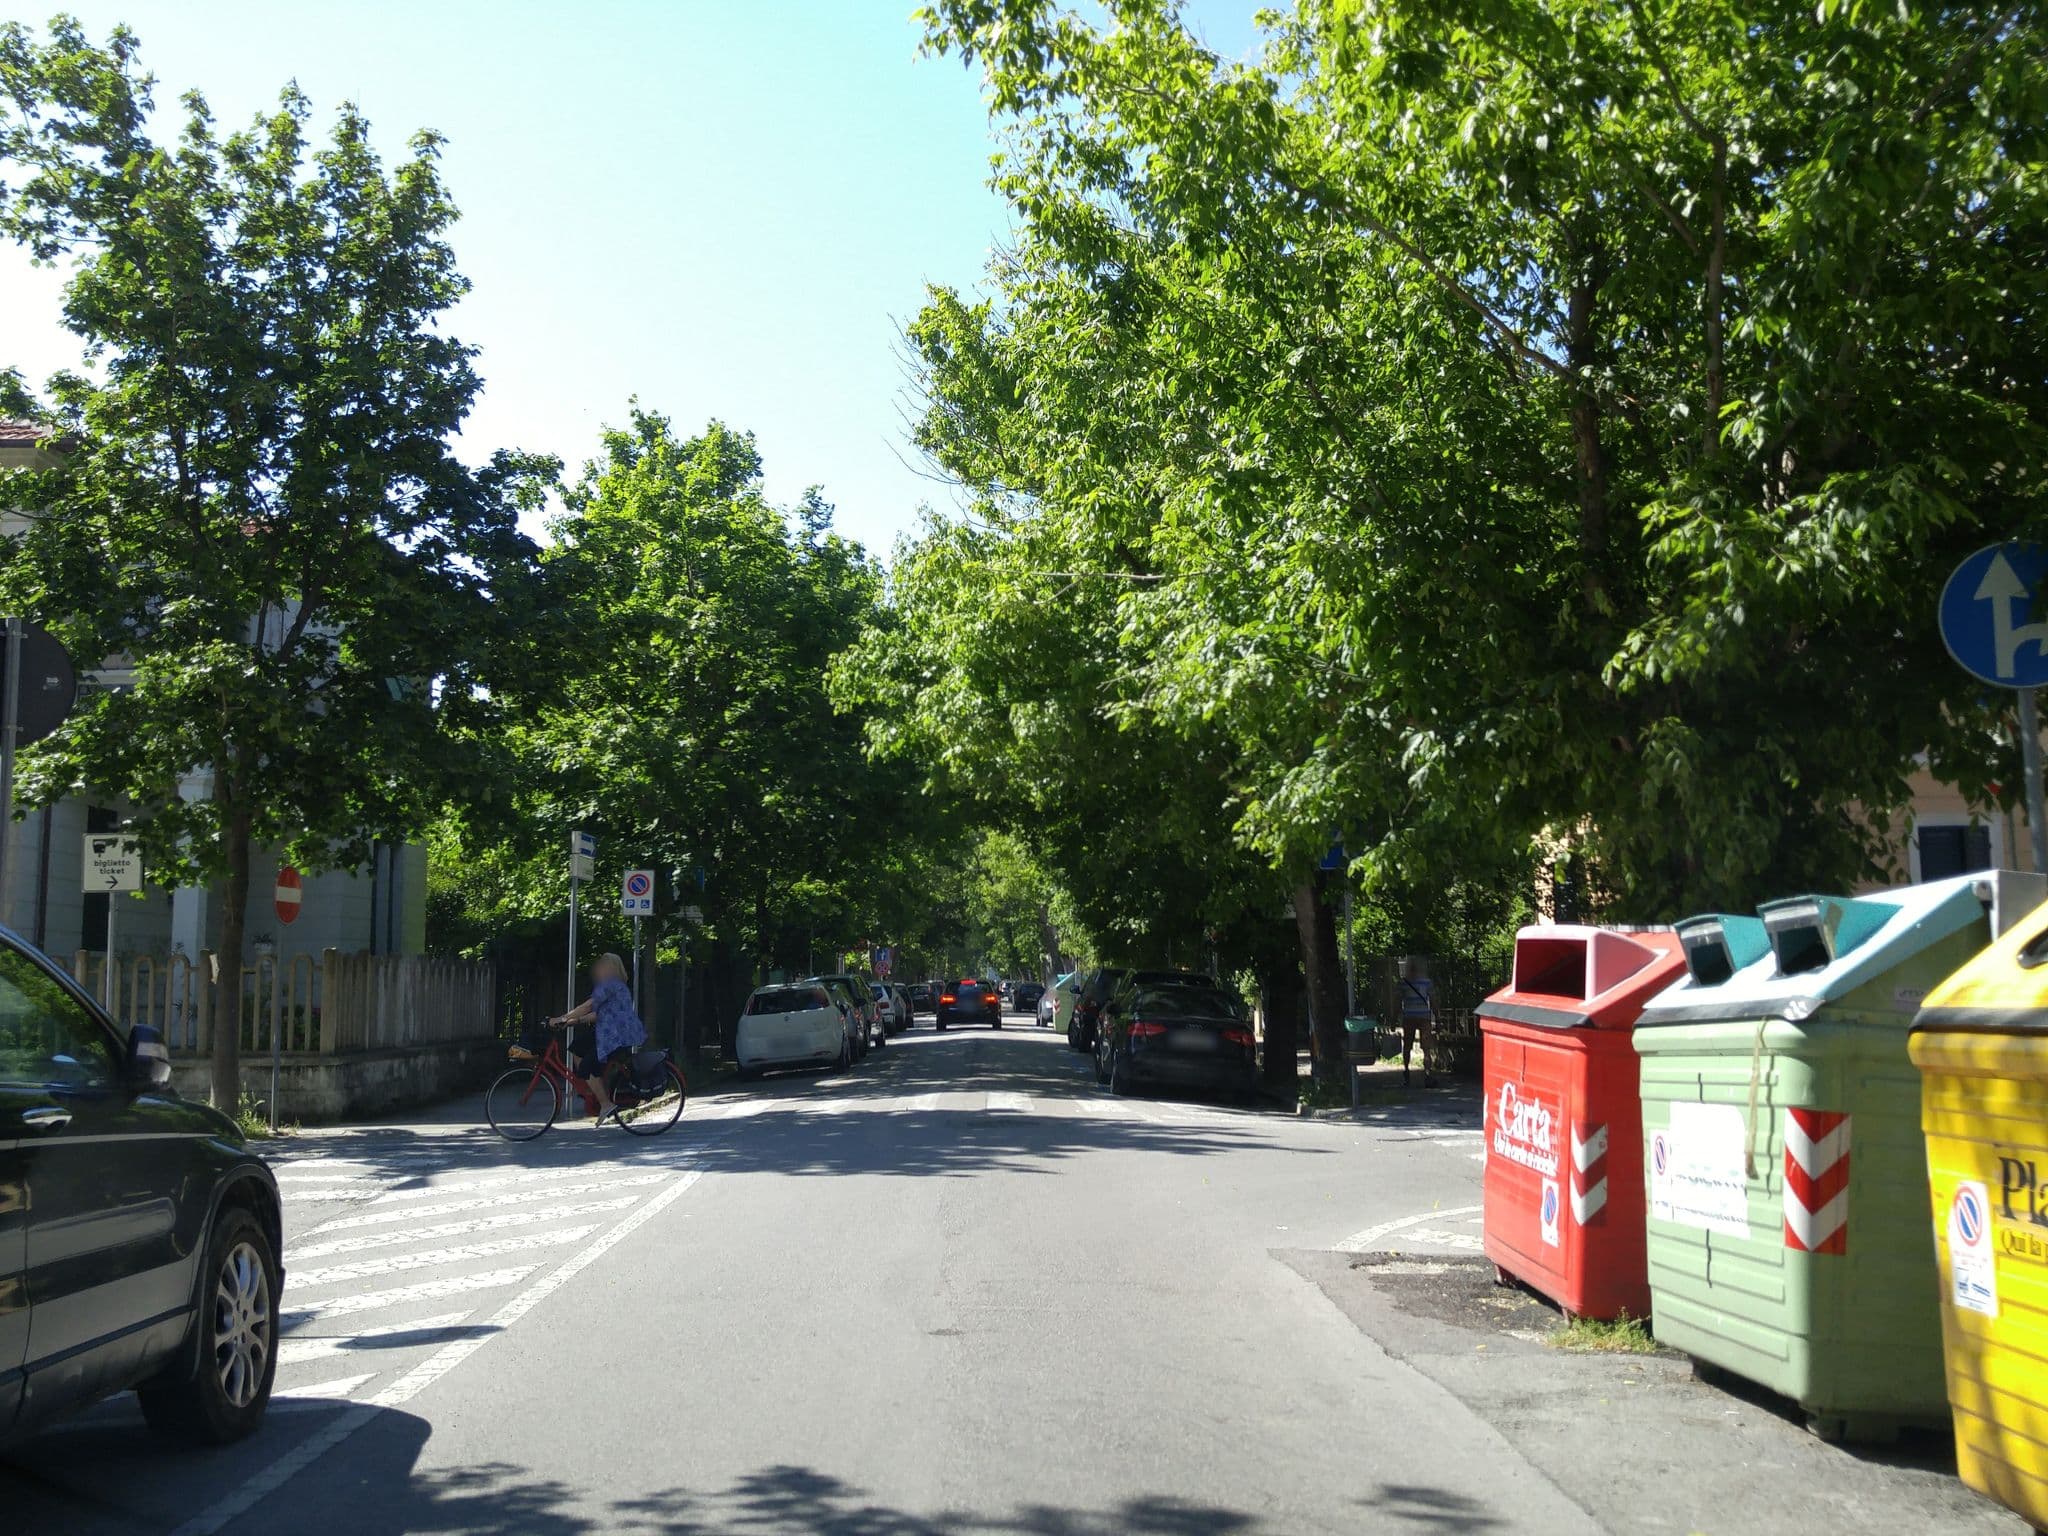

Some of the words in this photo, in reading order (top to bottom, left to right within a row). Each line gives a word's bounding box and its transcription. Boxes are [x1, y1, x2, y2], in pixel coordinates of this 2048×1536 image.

[94, 860, 131, 868] biglietto
[1499, 1082, 1551, 1151] Carta
[2001, 1228, 2026, 1256] Qui
